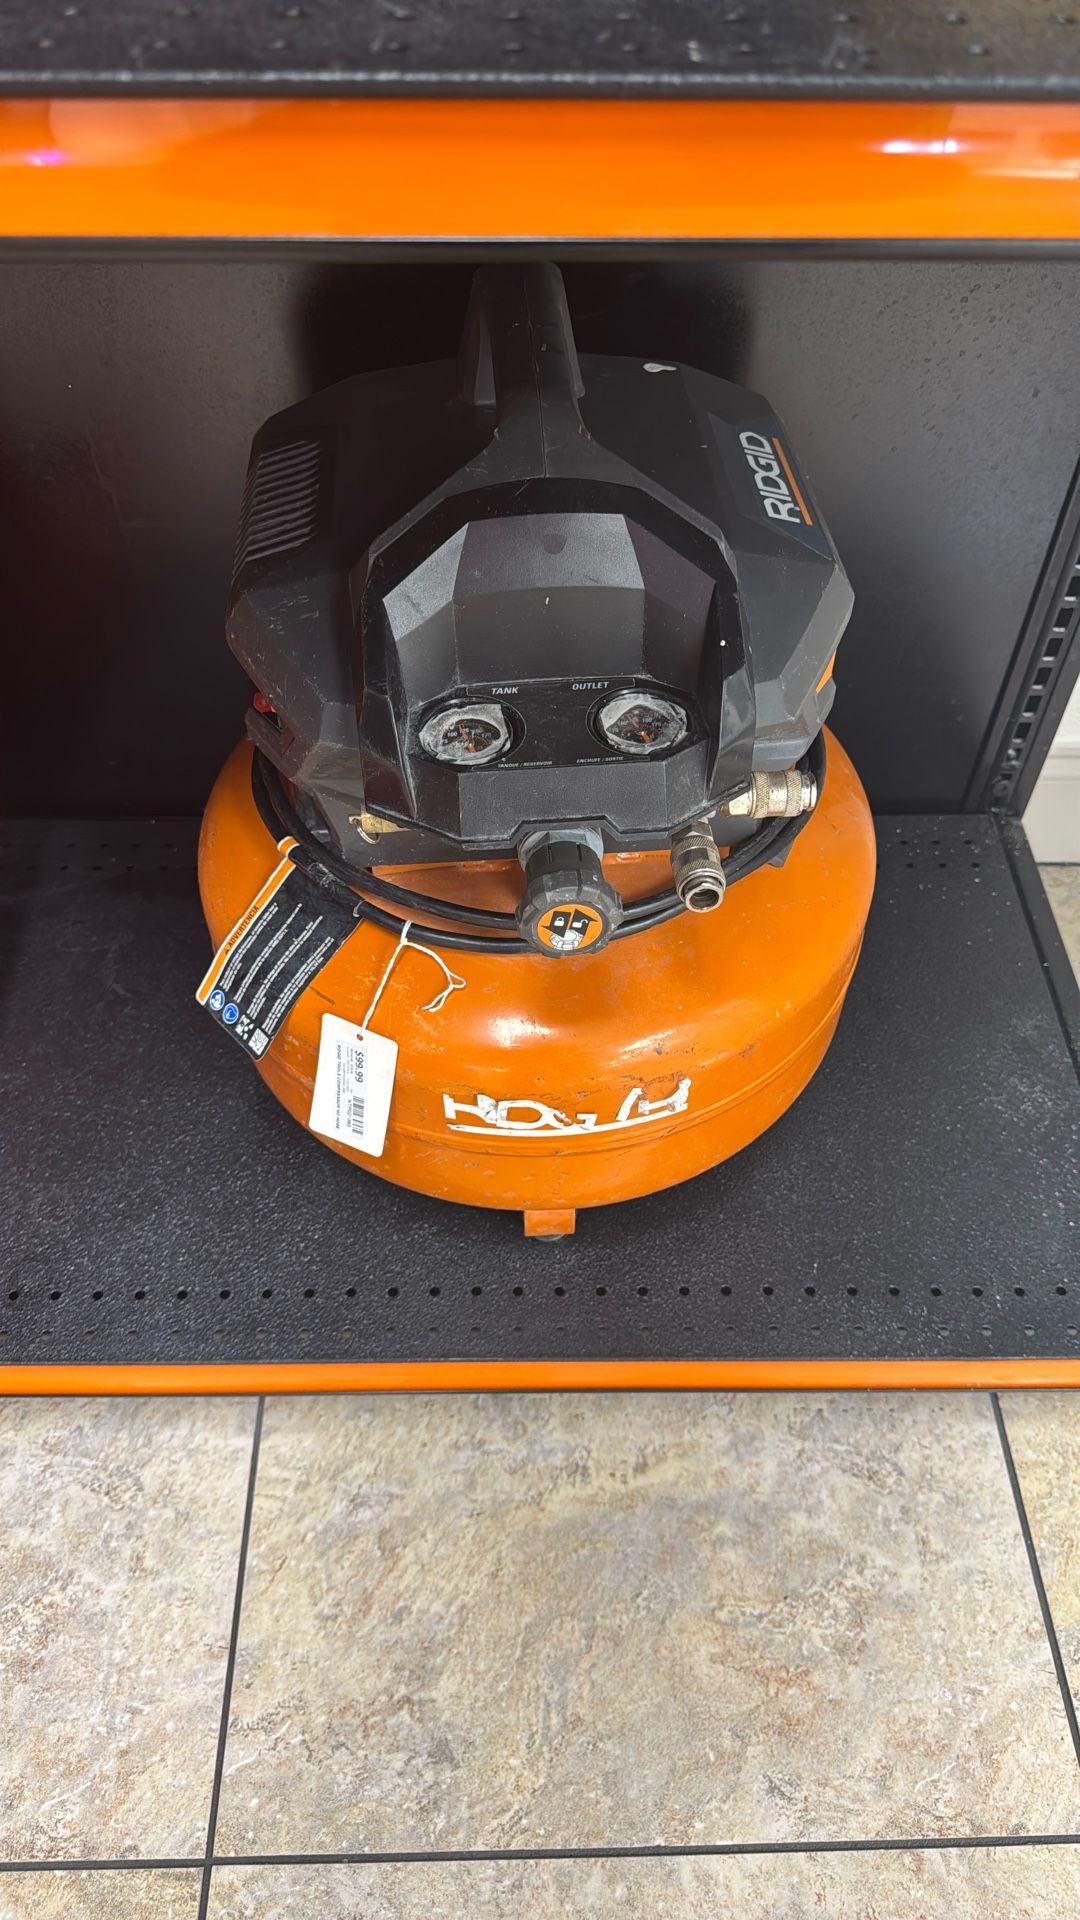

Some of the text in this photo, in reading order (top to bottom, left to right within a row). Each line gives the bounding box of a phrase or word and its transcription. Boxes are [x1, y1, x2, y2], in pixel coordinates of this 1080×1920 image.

[739, 431, 801, 524] RIDGID
[492, 686, 519, 695] TANK
[572, 681, 609, 690] OUTLET
[228, 906, 259, 948] ADVERTENCIA
[355, 1050, 364, 1083] $99.99
